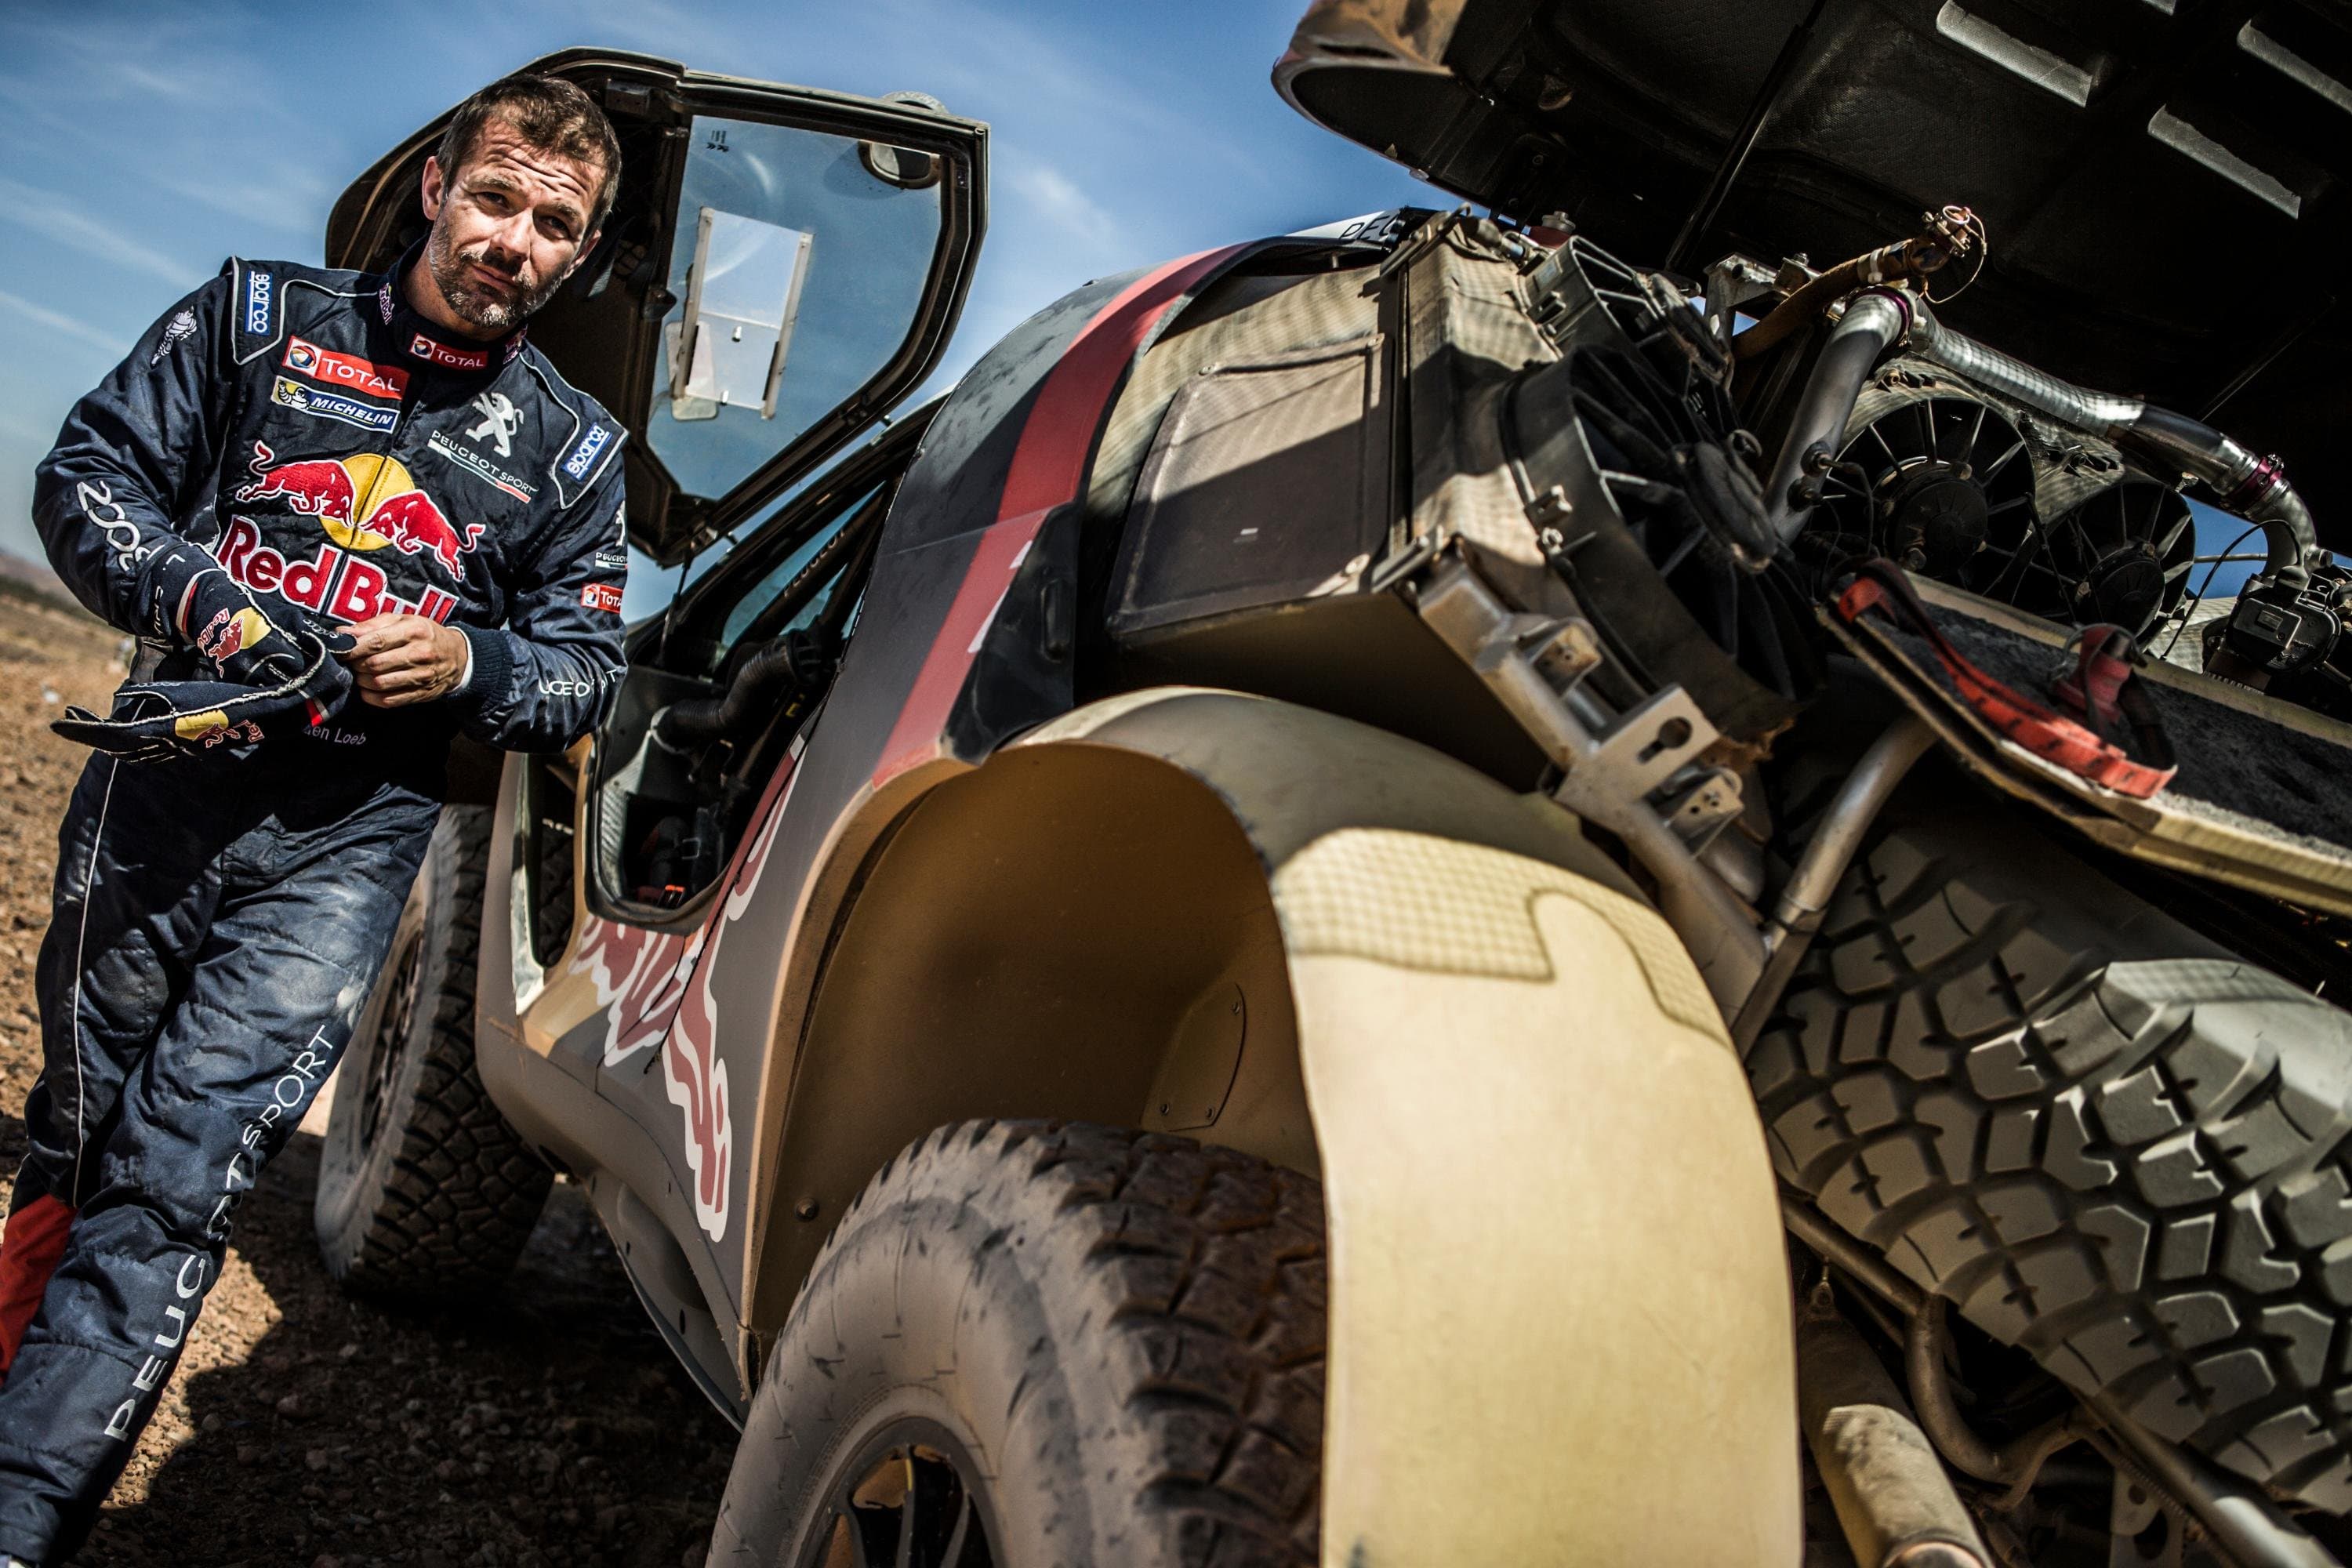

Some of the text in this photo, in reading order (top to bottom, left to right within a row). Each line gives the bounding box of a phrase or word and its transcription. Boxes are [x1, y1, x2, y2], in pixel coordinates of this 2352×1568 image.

[249, 272, 270, 333] sparco
[322, 358, 401, 394] TOTAL
[436, 350, 485, 368] TOTAL
[310, 396, 393, 425] MICHELIN
[431, 429, 539, 495] PEUGEOT SPORT
[565, 425, 605, 475] sparco
[215, 514, 347, 614] Red
[205, 608, 230, 639] Red
[334, 728, 367, 745] Loeb
[103, 1024, 333, 1443] PEUGT SPORT
